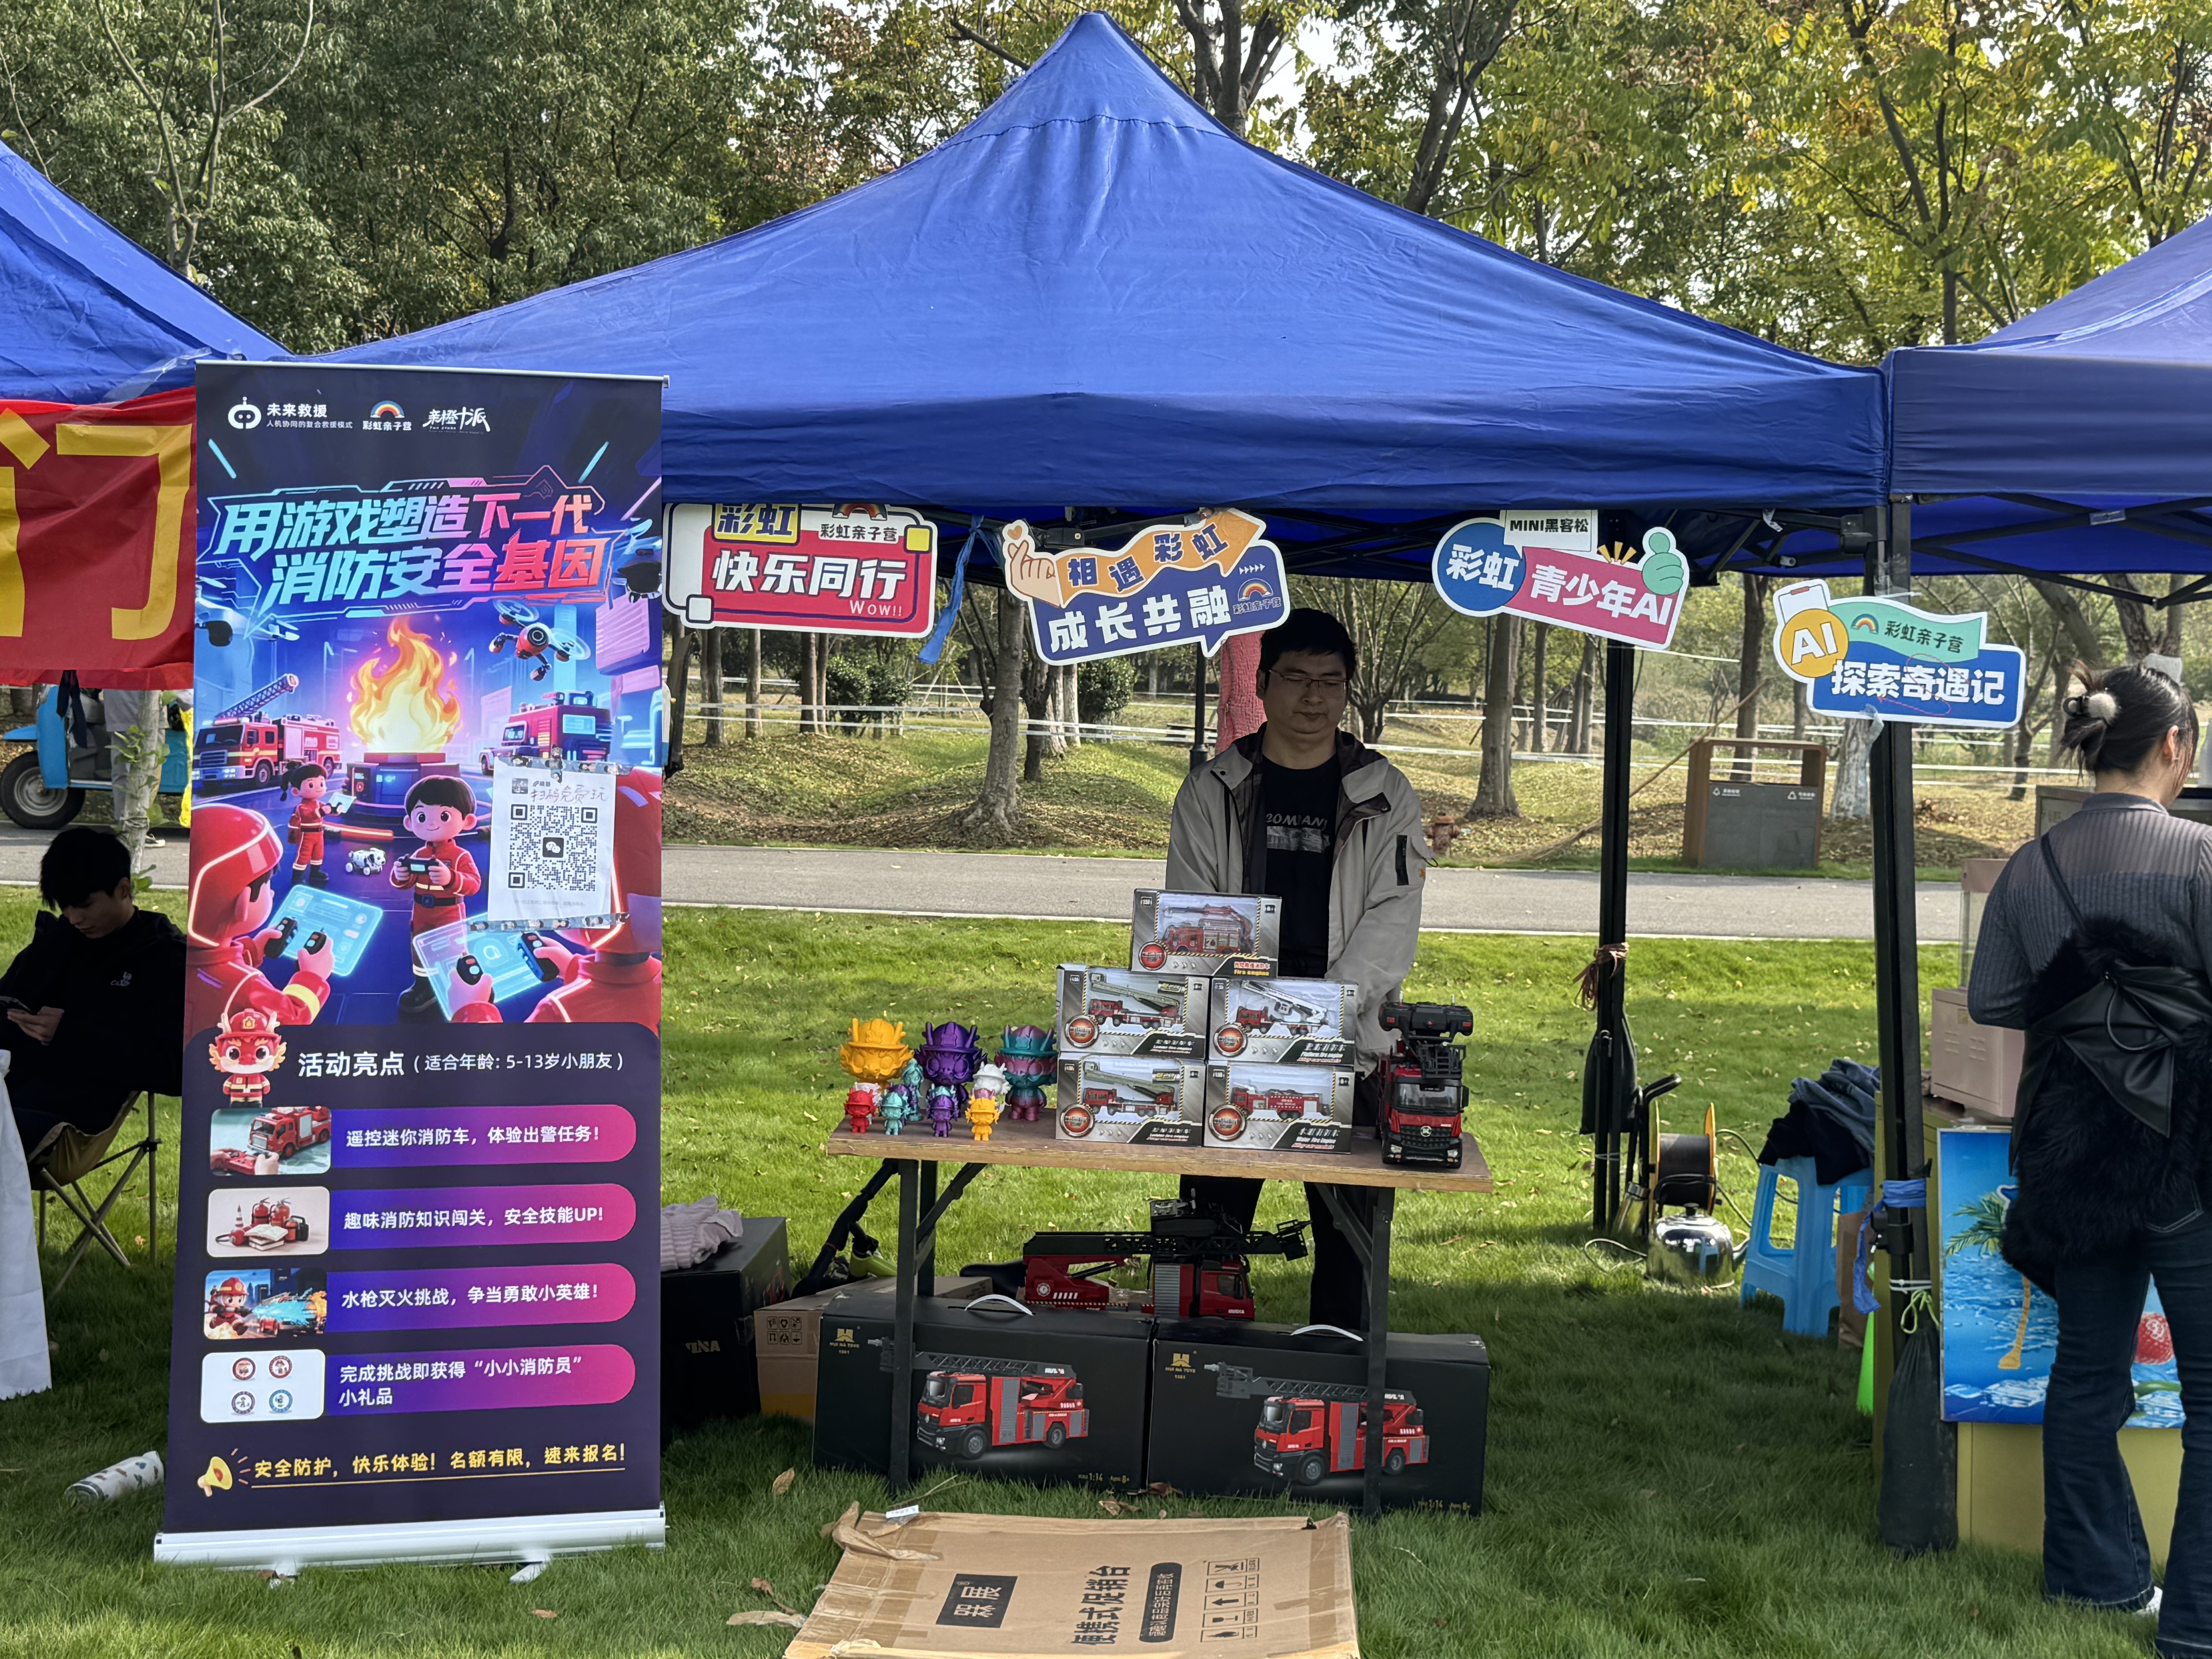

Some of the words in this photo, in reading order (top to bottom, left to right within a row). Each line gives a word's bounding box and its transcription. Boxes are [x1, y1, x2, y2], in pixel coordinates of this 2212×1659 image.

[267, 404, 327, 418] 未来救援
[362, 420, 412, 431] 彩虹亲子营
[213, 493, 592, 561] 用游戏塑造下一代
[717, 504, 796, 536] 彩虹
[819, 524, 899, 542] 彩虹亲子营
[1510, 518, 1589, 533] MINI黑客松
[259, 530, 607, 616] 消防安全基因
[1067, 522, 1228, 592] 相遇彩虹
[1446, 543, 1520, 591] 彩虹
[712, 549, 907, 601] 快乐同行
[1530, 563, 1673, 625] 青少年AI
[1048, 584, 1231, 654] 成长共融
[1791, 622, 1838, 666] AI
[1884, 620, 1964, 653] 彩虹亲子营
[1831, 659, 2005, 705] 探索奇遇记
[298, 1051, 405, 1078] 活动亮点
[346, 1125, 600, 1149] 遥控迷你消防车，体验出警任务！
[343, 1205, 604, 1230] 趣味消防知识闯关，安全技能UP!
[341, 1283, 598, 1309] 水枪灭火挑战，争当勇敢小英雄！
[338, 1387, 393, 1407] 小礼品
[254, 1443, 625, 1479] 安全防护，快乐体验！名额有限，速来报名！
[1071, 1565, 1131, 1647] 便携式促销台
